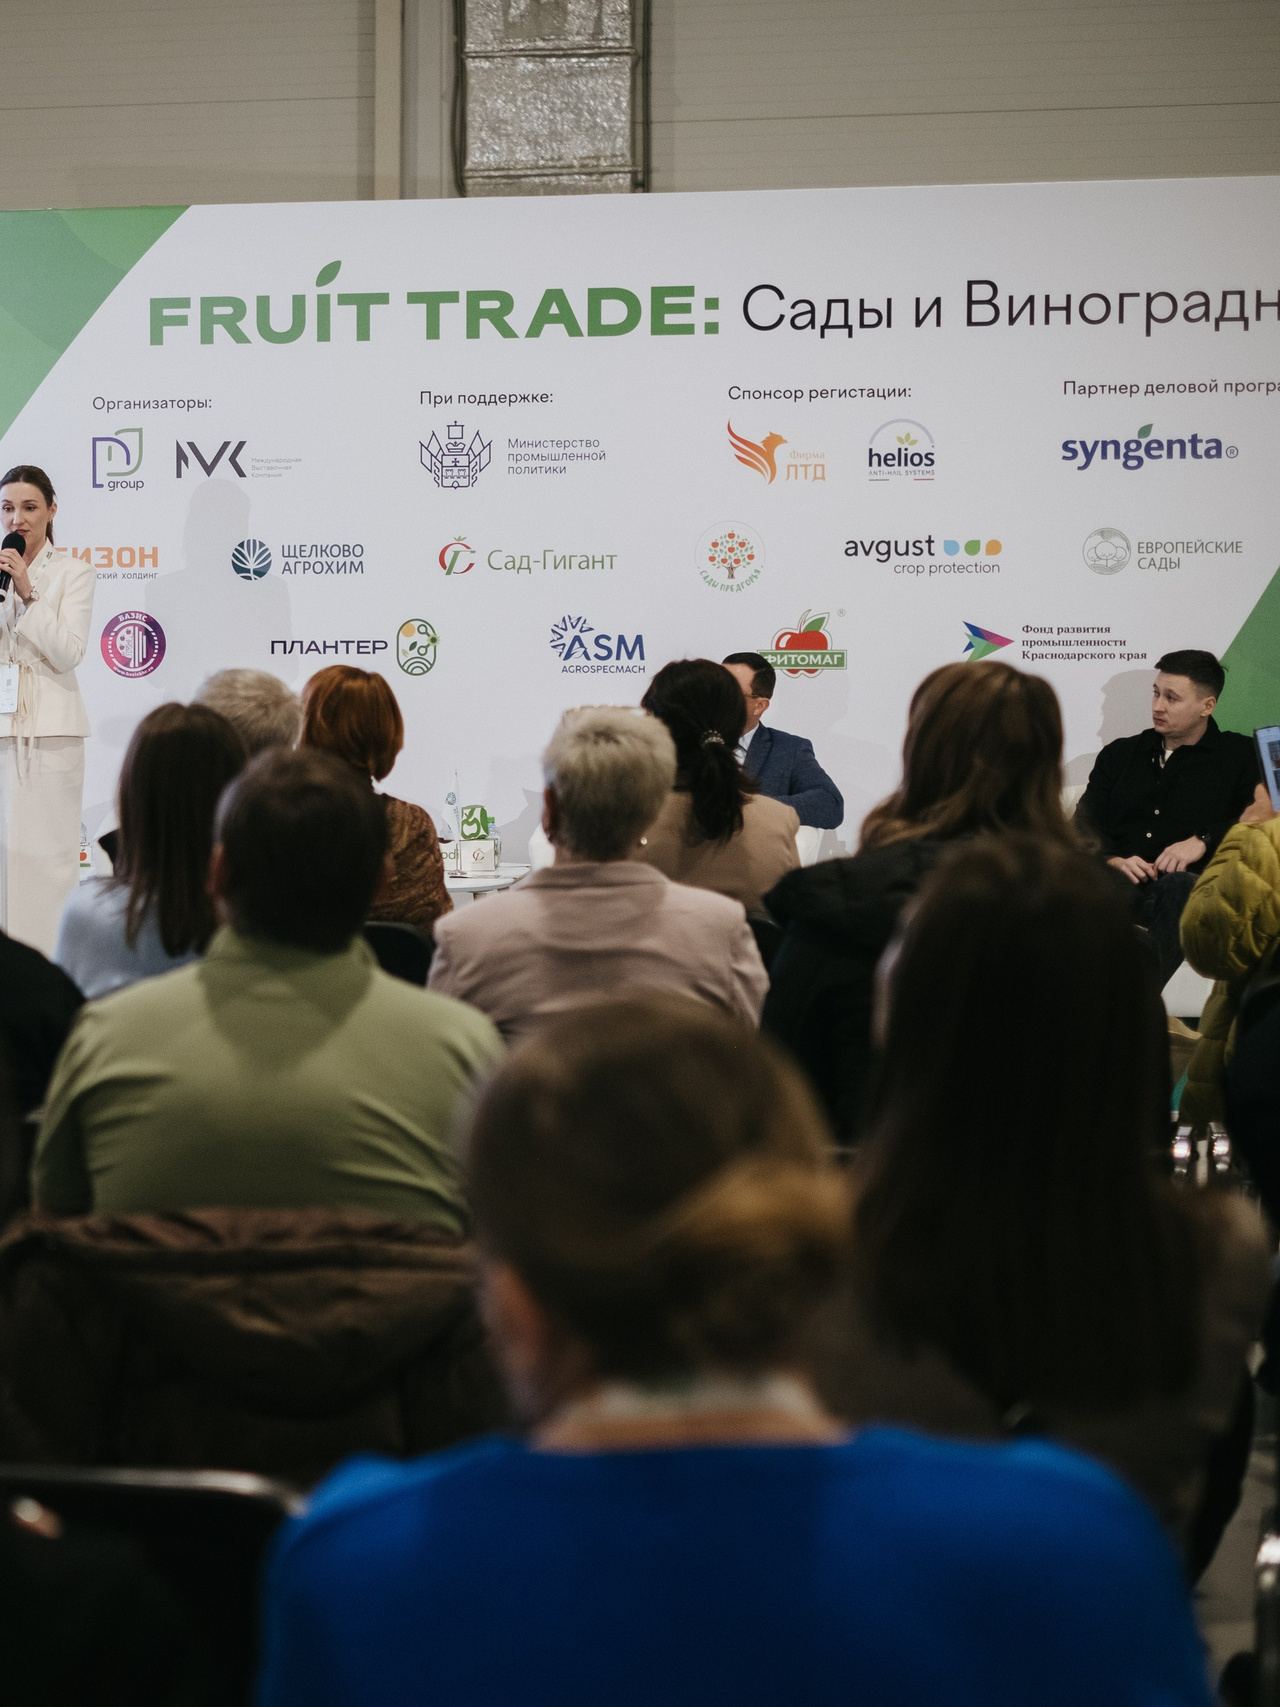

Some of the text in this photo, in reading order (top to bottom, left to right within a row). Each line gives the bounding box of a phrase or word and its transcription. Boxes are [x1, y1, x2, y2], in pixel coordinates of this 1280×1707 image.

[149, 285, 719, 346] FRUIT TRADE:
[743, 284, 892, 339] Сады
[915, 297, 941, 327] и
[729, 386, 911, 402] Спонсор регистации:
[1064, 381, 1139, 398] Партнер
[1144, 379, 1218, 396] деловой
[93, 397, 211, 413] Организаторы:
[421, 391, 552, 408] При поддержке:
[508, 439, 599, 450] Министерство
[508, 450, 605, 464] промышленной
[789, 451, 825, 461] Фирма
[868, 447, 935, 467] helios
[508, 466, 566, 474] политики
[786, 464, 826, 482] ЛТД
[108, 481, 144, 491] group
[281, 544, 364, 560] ЩЕЛКОВО
[845, 535, 935, 563] avgust
[1137, 538, 1243, 555] ЕВРОПЕЙСКИЕ
[281, 560, 364, 575] АГРОХИМ
[487, 549, 618, 574] Сад-Гигант
[1137, 556, 1181, 572] САДЫ
[121, 572, 159, 580] ХОЛДИНГ
[894, 563, 1000, 576] crop protection
[699, 569, 761, 593] САДЫ ПРЕДГОРЬЯ
[118, 612, 148, 622] БАЗИС
[1022, 625, 1110, 635] Фонд развития
[271, 640, 388, 655] ПЛАНТЕР
[563, 634, 645, 661] ASM
[1023, 640, 1126, 648] промышленности
[764, 654, 842, 665] ФИТОМАГ
[1022, 651, 1146, 661] Краснодарского края
[561, 665, 646, 674] AGROSPECMACH
